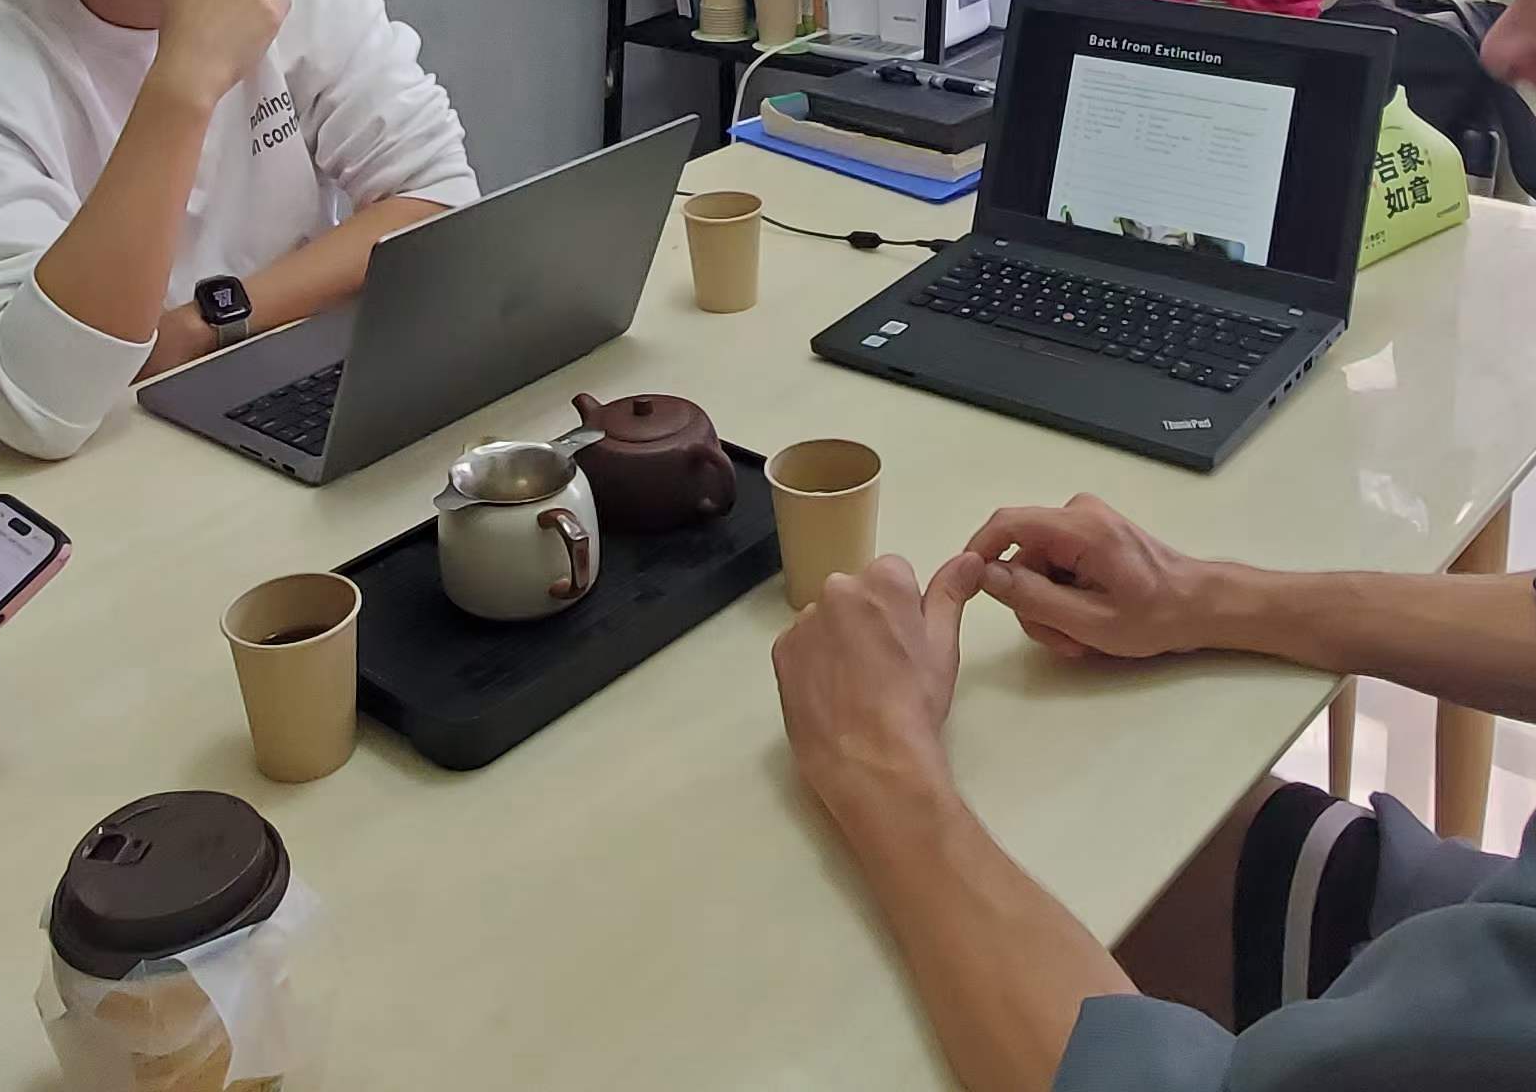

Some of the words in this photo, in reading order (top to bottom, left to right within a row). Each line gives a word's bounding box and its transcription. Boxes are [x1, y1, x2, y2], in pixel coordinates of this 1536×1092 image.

[1088, 34, 1118, 50] Back
[1121, 37, 1151, 55] from
[1154, 43, 1223, 65] Extinction
[1374, 142, 1425, 184] 吉象
[1384, 176, 1433, 219] 如意
